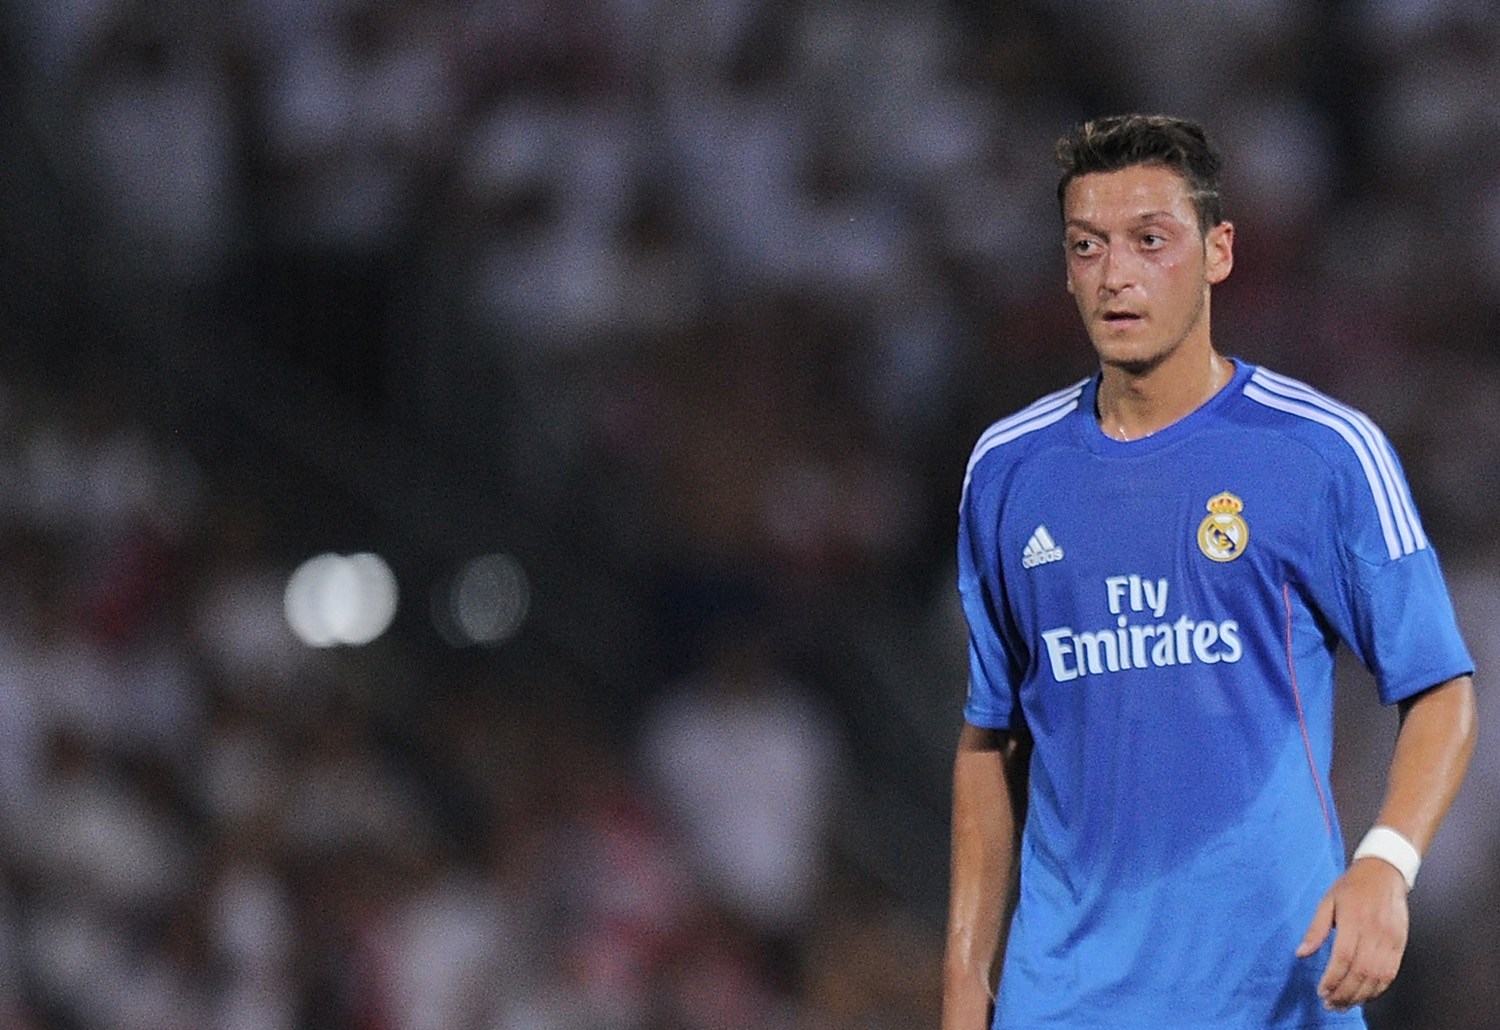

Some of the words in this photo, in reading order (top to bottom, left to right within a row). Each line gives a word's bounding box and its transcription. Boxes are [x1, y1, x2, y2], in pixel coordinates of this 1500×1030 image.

[1022, 547, 1064, 569] adidas
[1104, 573, 1169, 617] Fly
[1041, 614, 1243, 682] Emirates
